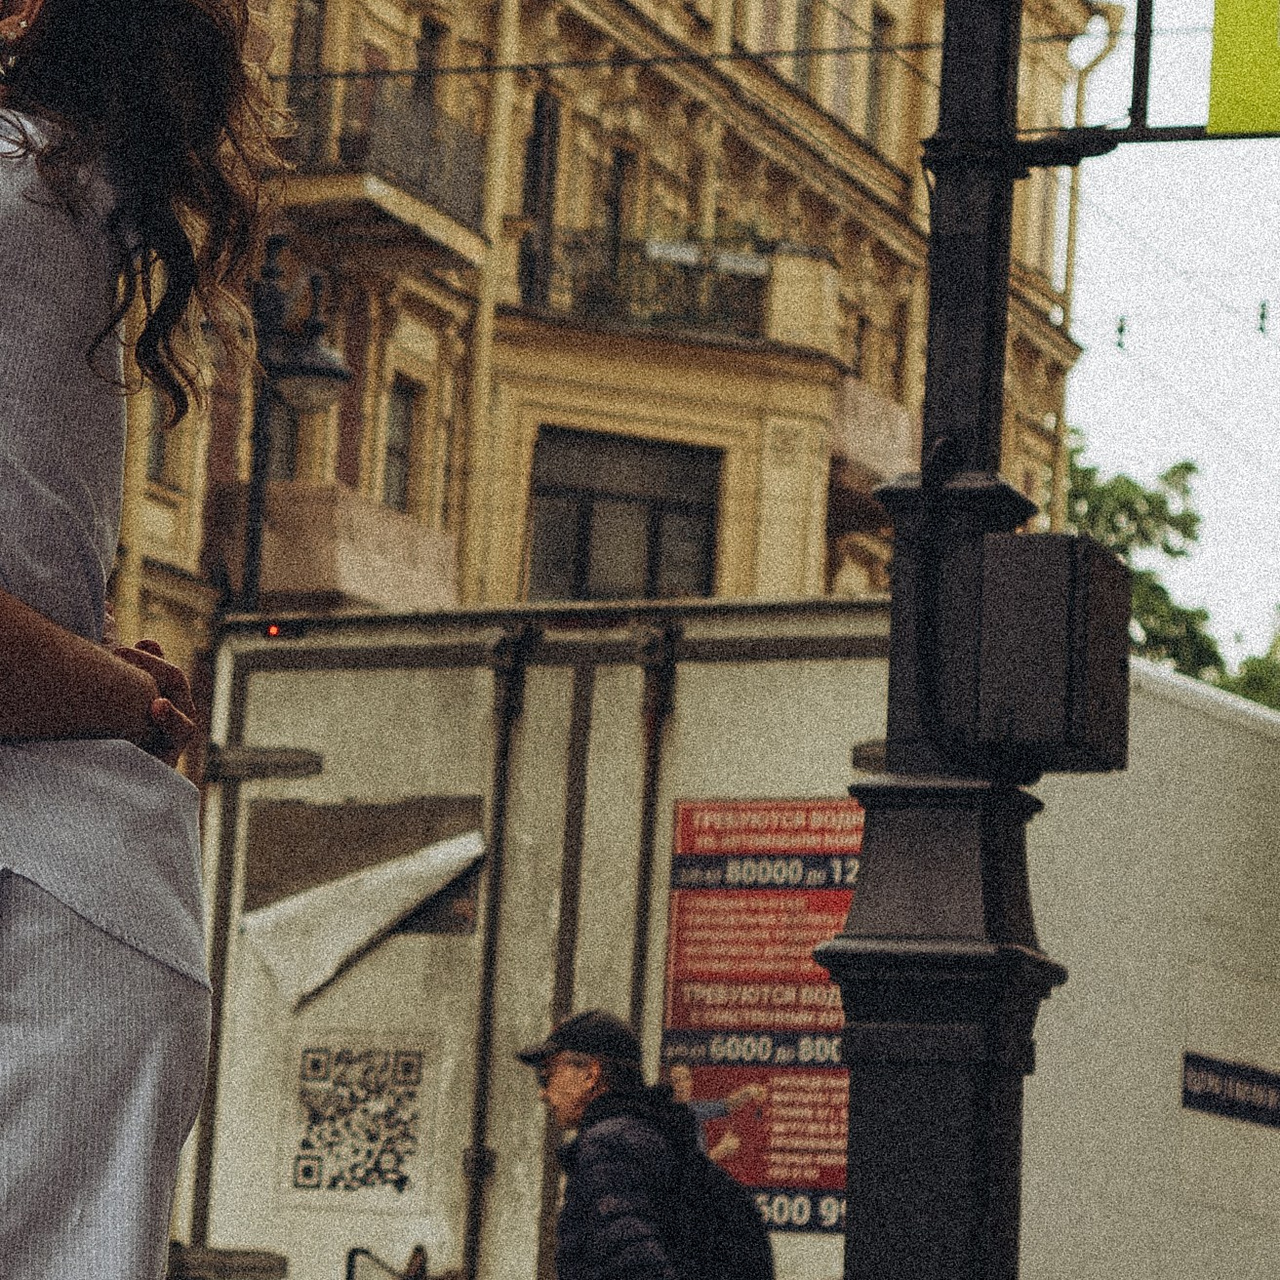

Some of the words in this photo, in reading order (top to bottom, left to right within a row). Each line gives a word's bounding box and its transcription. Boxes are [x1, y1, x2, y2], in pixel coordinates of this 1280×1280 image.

[831, 857, 859, 884] 12
[682, 982, 796, 1005] ТРЕБУЮТСЯ
[710, 1035, 772, 1061] 6000
